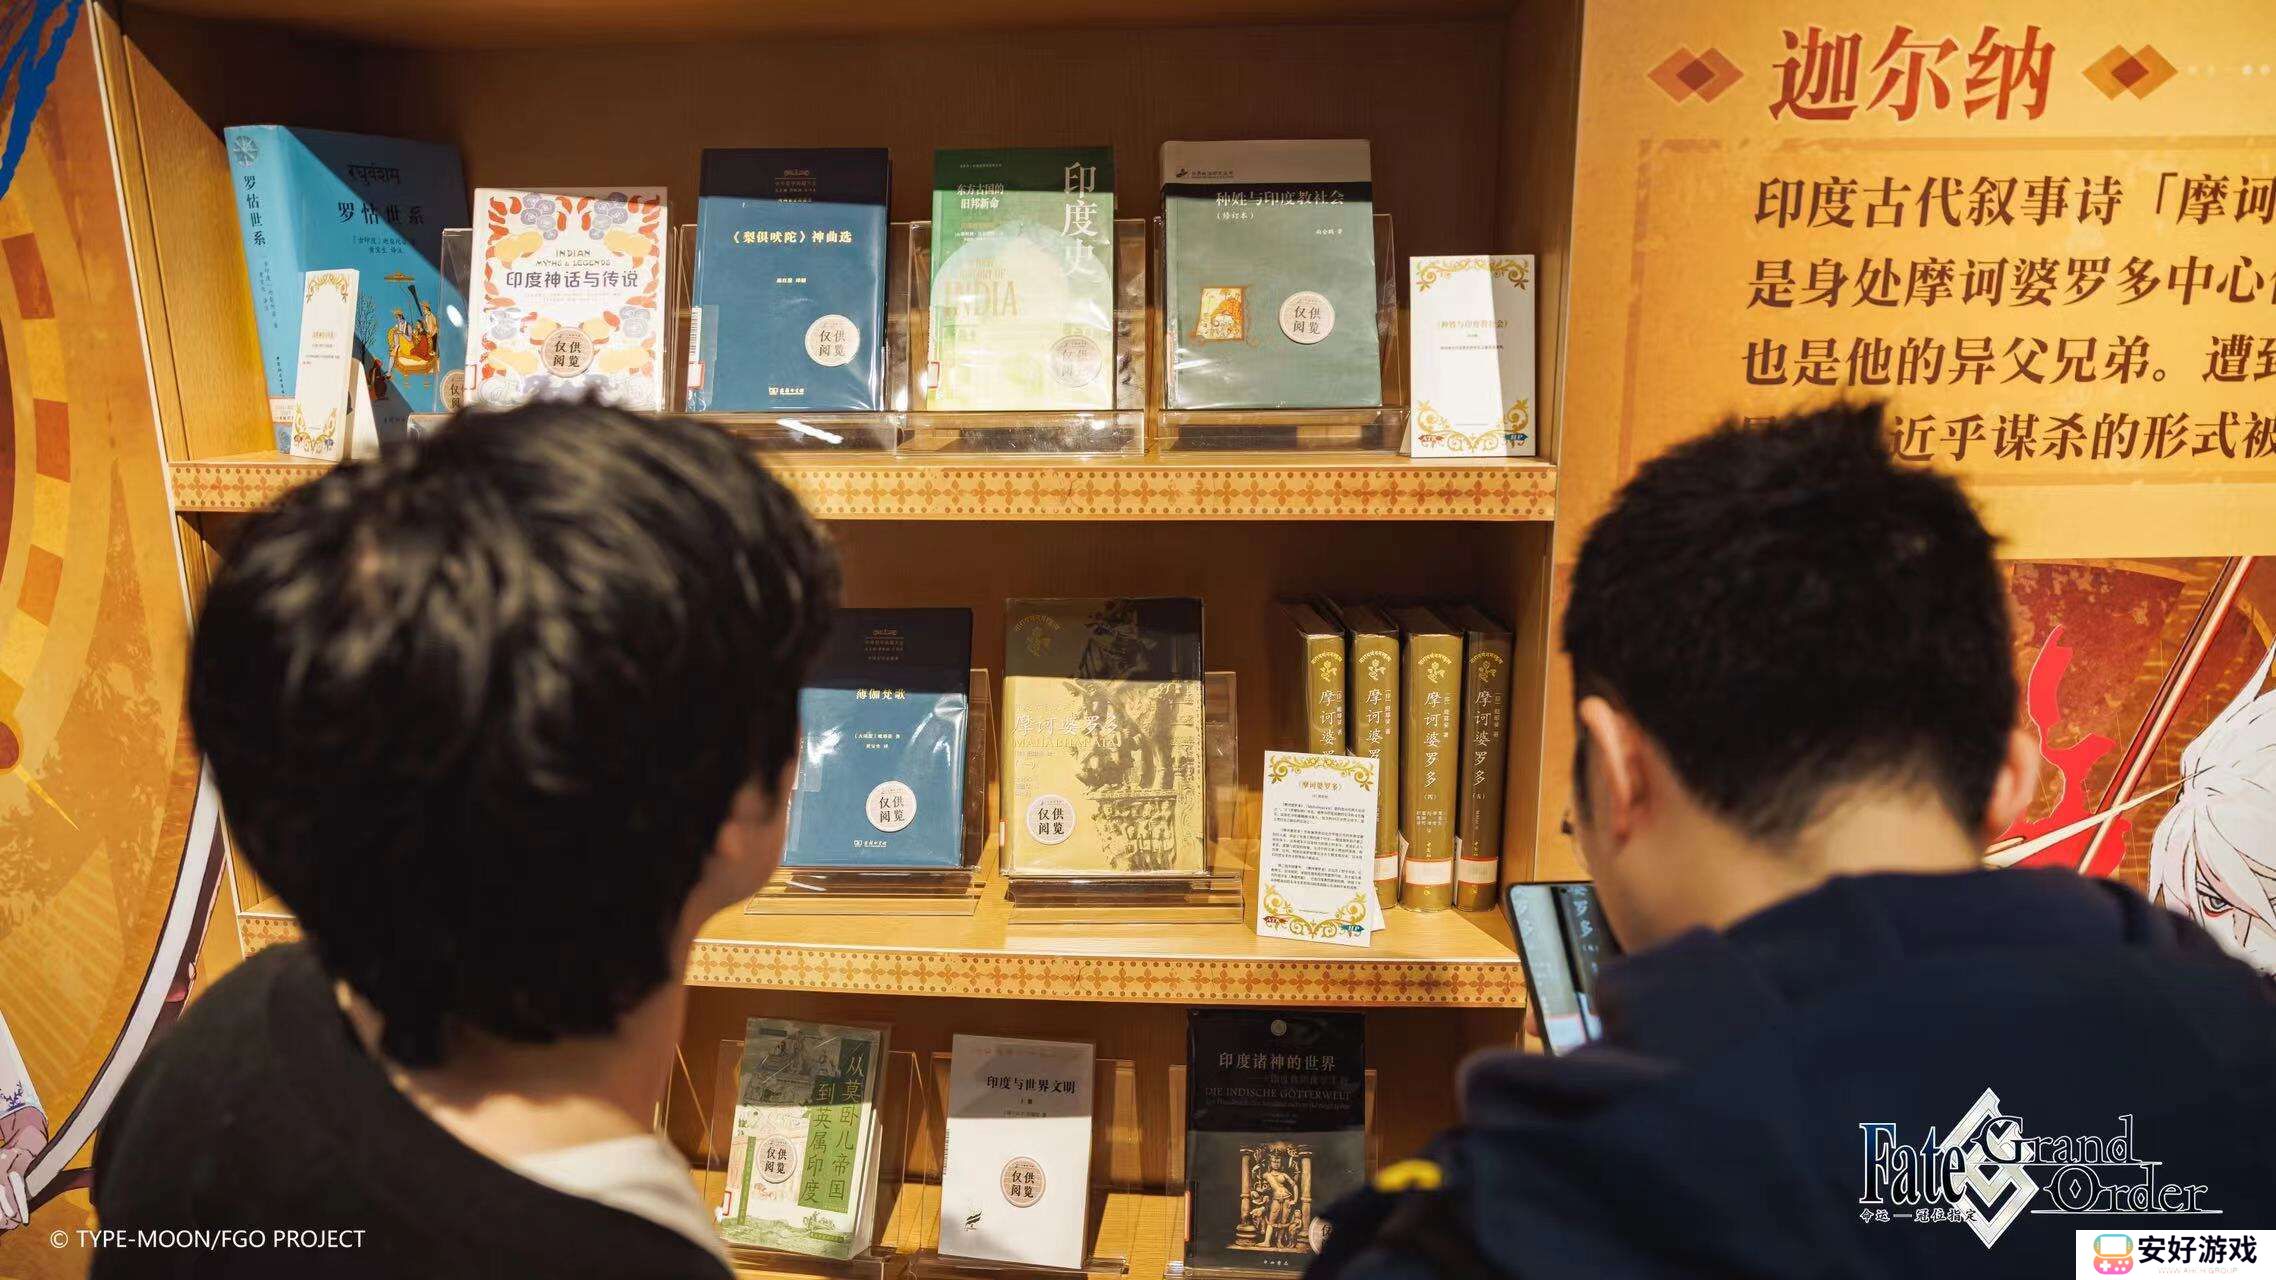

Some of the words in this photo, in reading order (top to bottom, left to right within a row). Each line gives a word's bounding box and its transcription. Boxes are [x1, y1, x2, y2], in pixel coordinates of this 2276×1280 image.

[1769, 24, 2056, 121] 迦尔纳
[956, 183, 1004, 196] 东方古国的
[1215, 190, 1345, 207] 种姓与印度教社会
[243, 175, 266, 246] 罗怙世系
[336, 201, 424, 224] 罗怙世系
[1061, 161, 1098, 276] 印度史
[555, 249, 591, 257] INDIAN
[506, 270, 639, 288] 印度神话与传说
[1747, 255, 2276, 309] 是身处摩诃婆罗多中心
[1293, 305, 1321, 320] 仅供
[1292, 321, 1321, 335] 阅览
[819, 330, 846, 343] 仅供
[554, 340, 582, 354] 仅供
[818, 345, 846, 358] 阅览
[553, 354, 581, 368] 阅览
[1888, 412, 2276, 463] 近乎谋杀的形式被
[1013, 715, 1119, 736] 摩诃婆罗多
[1424, 690, 1441, 788] 摩诃婆罗多
[1473, 690, 1491, 787] 摩诃婆罗多
[879, 795, 904, 808] 仅供
[879, 810, 905, 823] 阅览
[1037, 807, 1065, 821] 仅供
[1037, 821, 1065, 836] 阅览
[1218, 1052, 1337, 1072] 印度诸神的世界
[986, 1075, 1076, 1095] 印度与世界文明
[828, 1054, 864, 1201] 从莫卧儿帝国
[801, 1081, 835, 1204] 到英属印度
[766, 1146, 788, 1161] 仅供
[764, 1160, 786, 1175] 阅览
[1011, 1169, 1036, 1184] 仅供
[1010, 1184, 1035, 1198] 阅览
